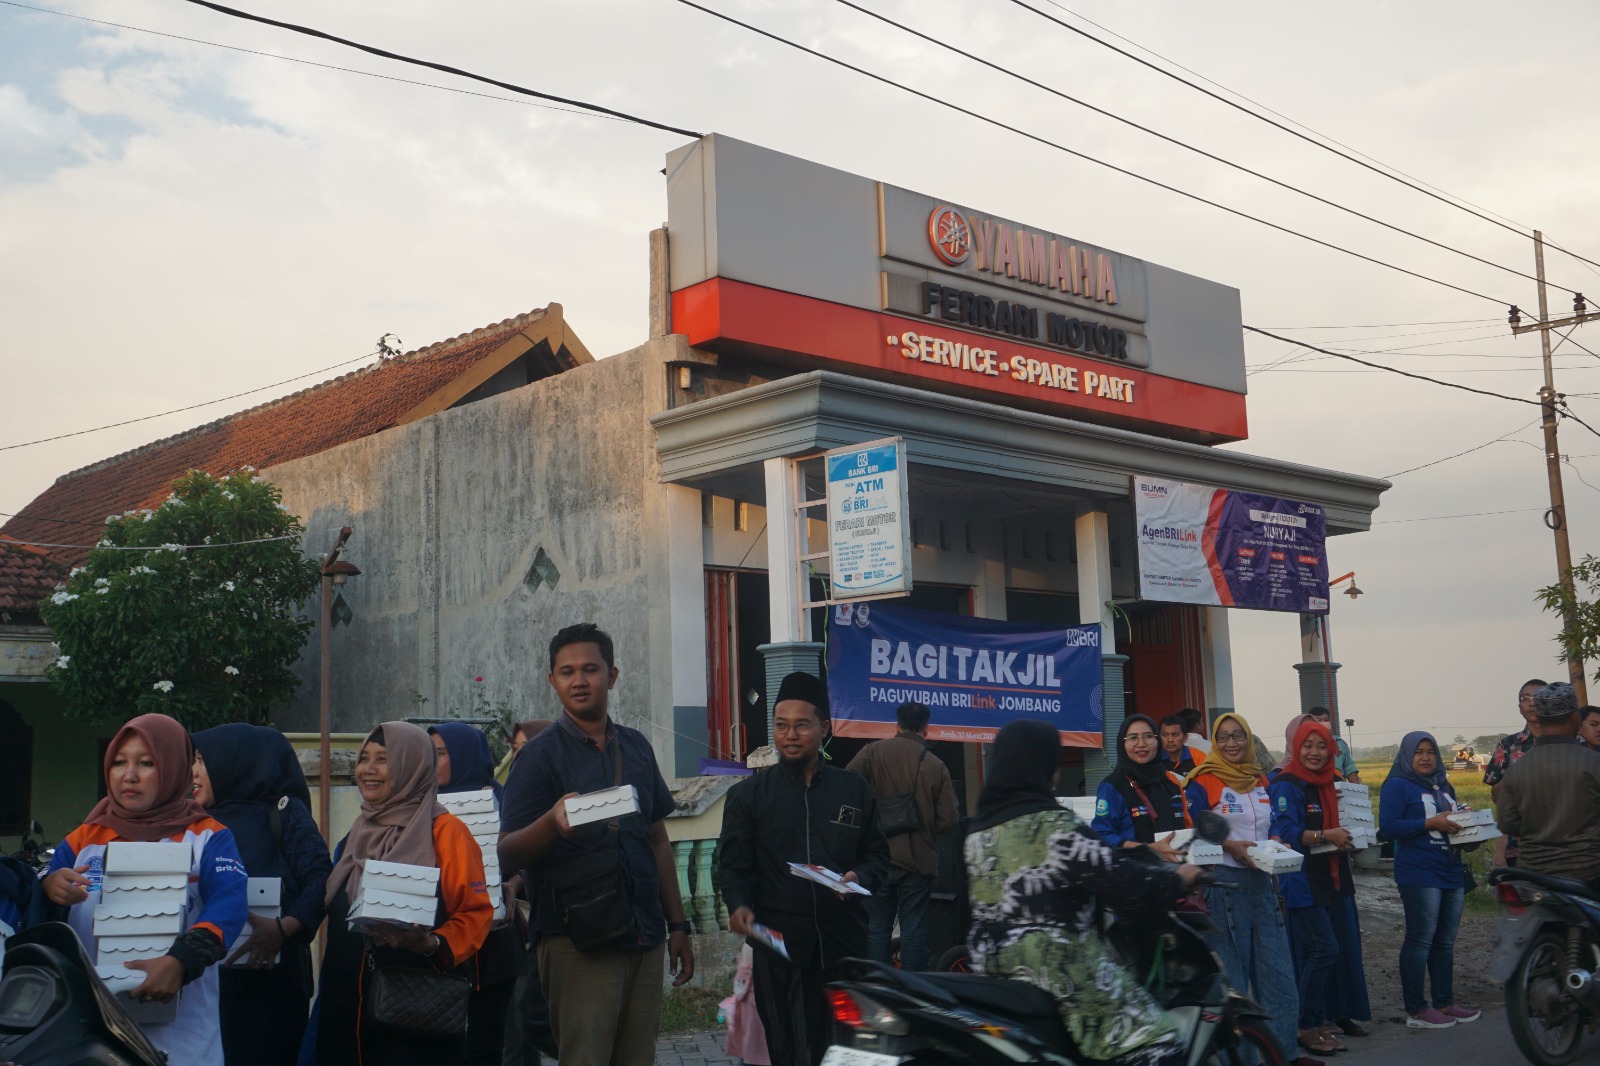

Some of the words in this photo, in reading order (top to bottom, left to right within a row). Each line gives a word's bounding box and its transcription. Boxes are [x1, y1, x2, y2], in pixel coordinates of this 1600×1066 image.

[969, 216, 1118, 305] YAMAHA
[922, 282, 1039, 339] FERRARI
[1047, 312, 1128, 360] MOTOR
[901, 331, 998, 376] SERVICE
[1009, 355, 1078, 392] SPARE
[1084, 371, 1135, 404] PART
[848, 467, 866, 477] BANK
[867, 465, 879, 473] BRI
[855, 478, 883, 494] ATM
[1141, 484, 1168, 494] BUMN
[835, 516, 864, 531] FERARI
[866, 512, 896, 527] MOTOR
[1142, 524, 1197, 543] AgenBRILink
[1079, 631, 1098, 647] BRI
[870, 638, 947, 679] BAGI
[953, 646, 1061, 688] TAKJIL
[870, 687, 949, 707] PAGUYUBAN
[951, 693, 996, 710] BRILink
[998, 696, 1061, 713] JOMBANG
